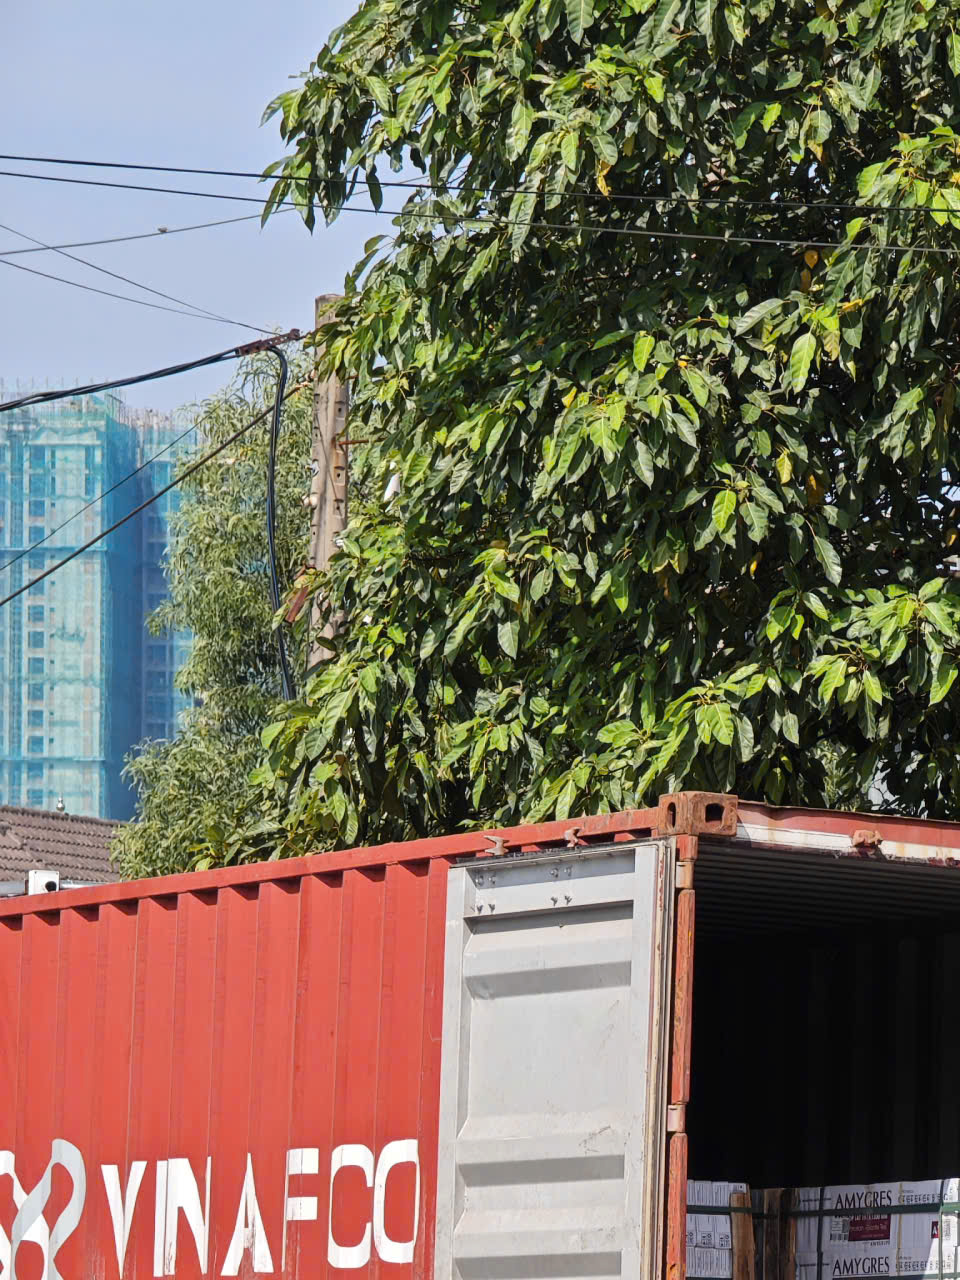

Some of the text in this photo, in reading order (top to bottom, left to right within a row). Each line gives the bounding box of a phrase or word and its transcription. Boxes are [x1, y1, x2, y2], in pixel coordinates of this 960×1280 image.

[101, 1138, 420, 1280] VINAFCO
[835, 1190, 892, 1209] AMYGRES
[833, 1256, 890, 1275] AMYGRES
